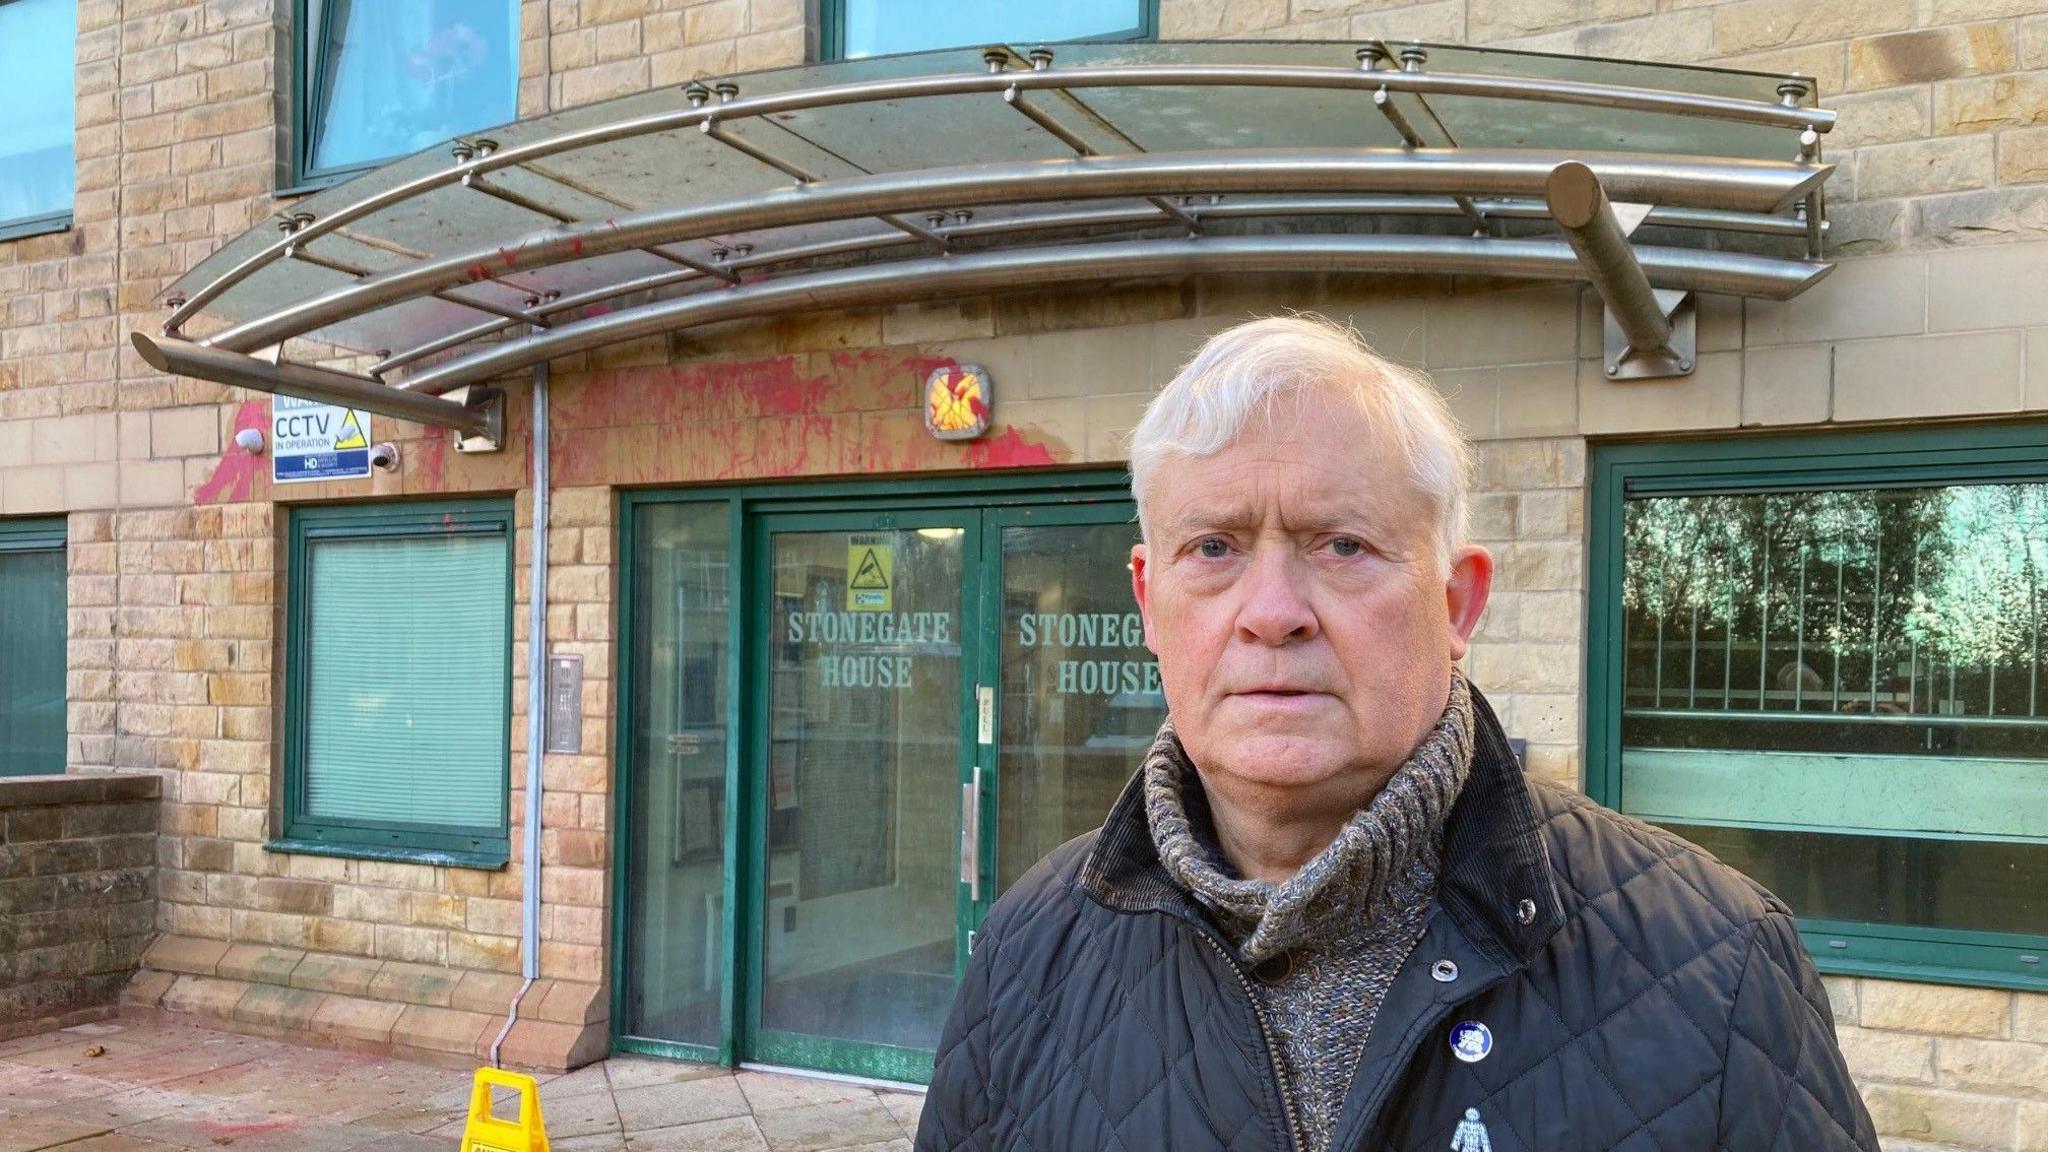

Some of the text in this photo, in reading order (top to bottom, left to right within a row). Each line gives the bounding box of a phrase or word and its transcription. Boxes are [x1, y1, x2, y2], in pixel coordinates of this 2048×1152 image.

[276, 413, 329, 438] CCTV
[275, 439, 330, 450] IN OPERATION
[304, 457, 318, 470] HD
[788, 612, 950, 643] STONEGATE
[1019, 613, 1147, 649] STONEG
[820, 656, 912, 688] HOUSE
[1057, 660, 1161, 695] HOUSE
